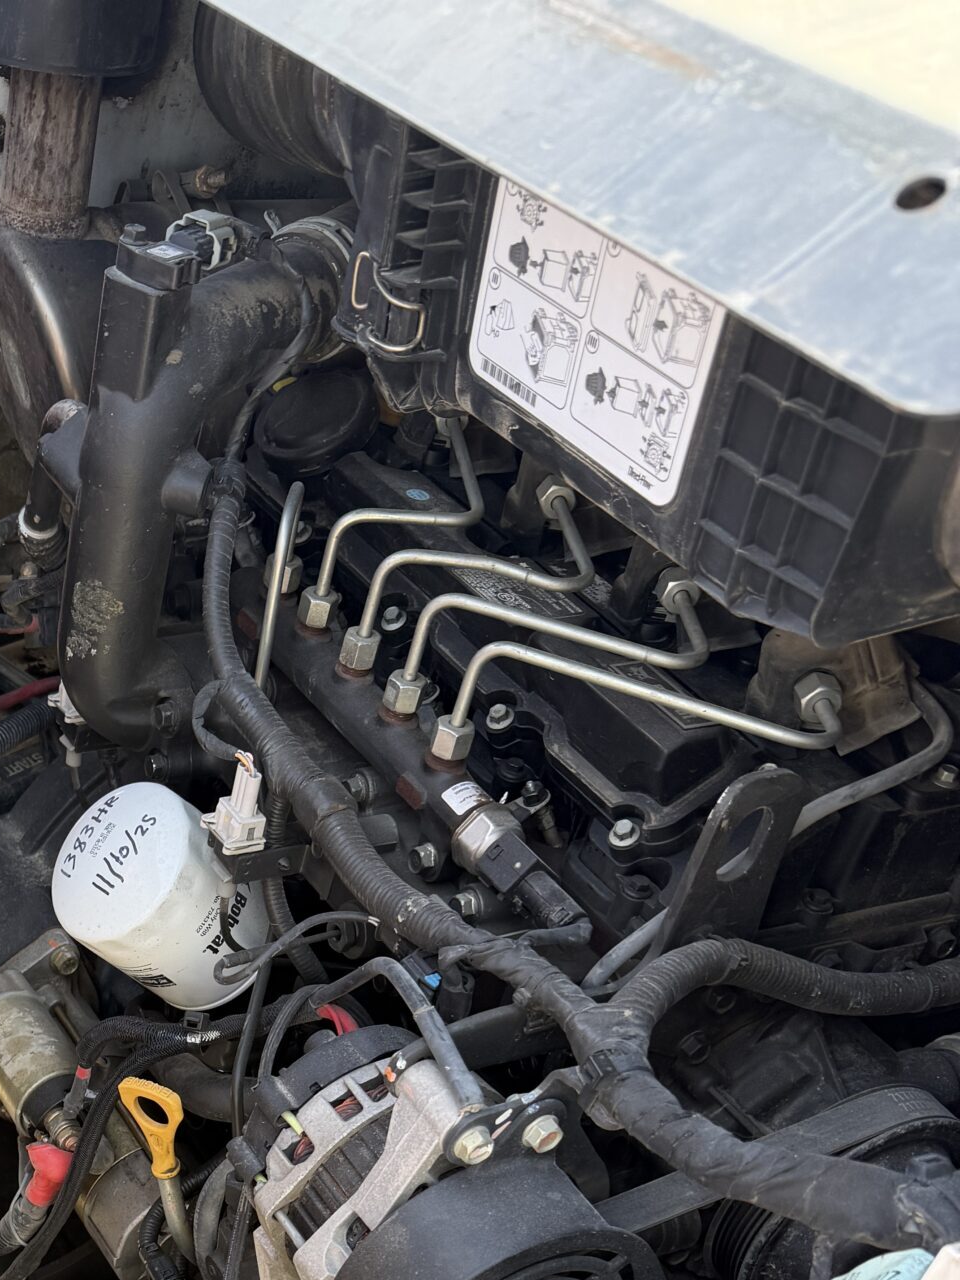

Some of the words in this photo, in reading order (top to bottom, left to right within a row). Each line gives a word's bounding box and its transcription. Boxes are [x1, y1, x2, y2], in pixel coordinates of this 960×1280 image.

[3, 751, 43, 777] START
[60, 795, 120, 878] 1383HR
[92, 813, 157, 895] 11/10/25
[205, 890, 248, 955] Bobat
